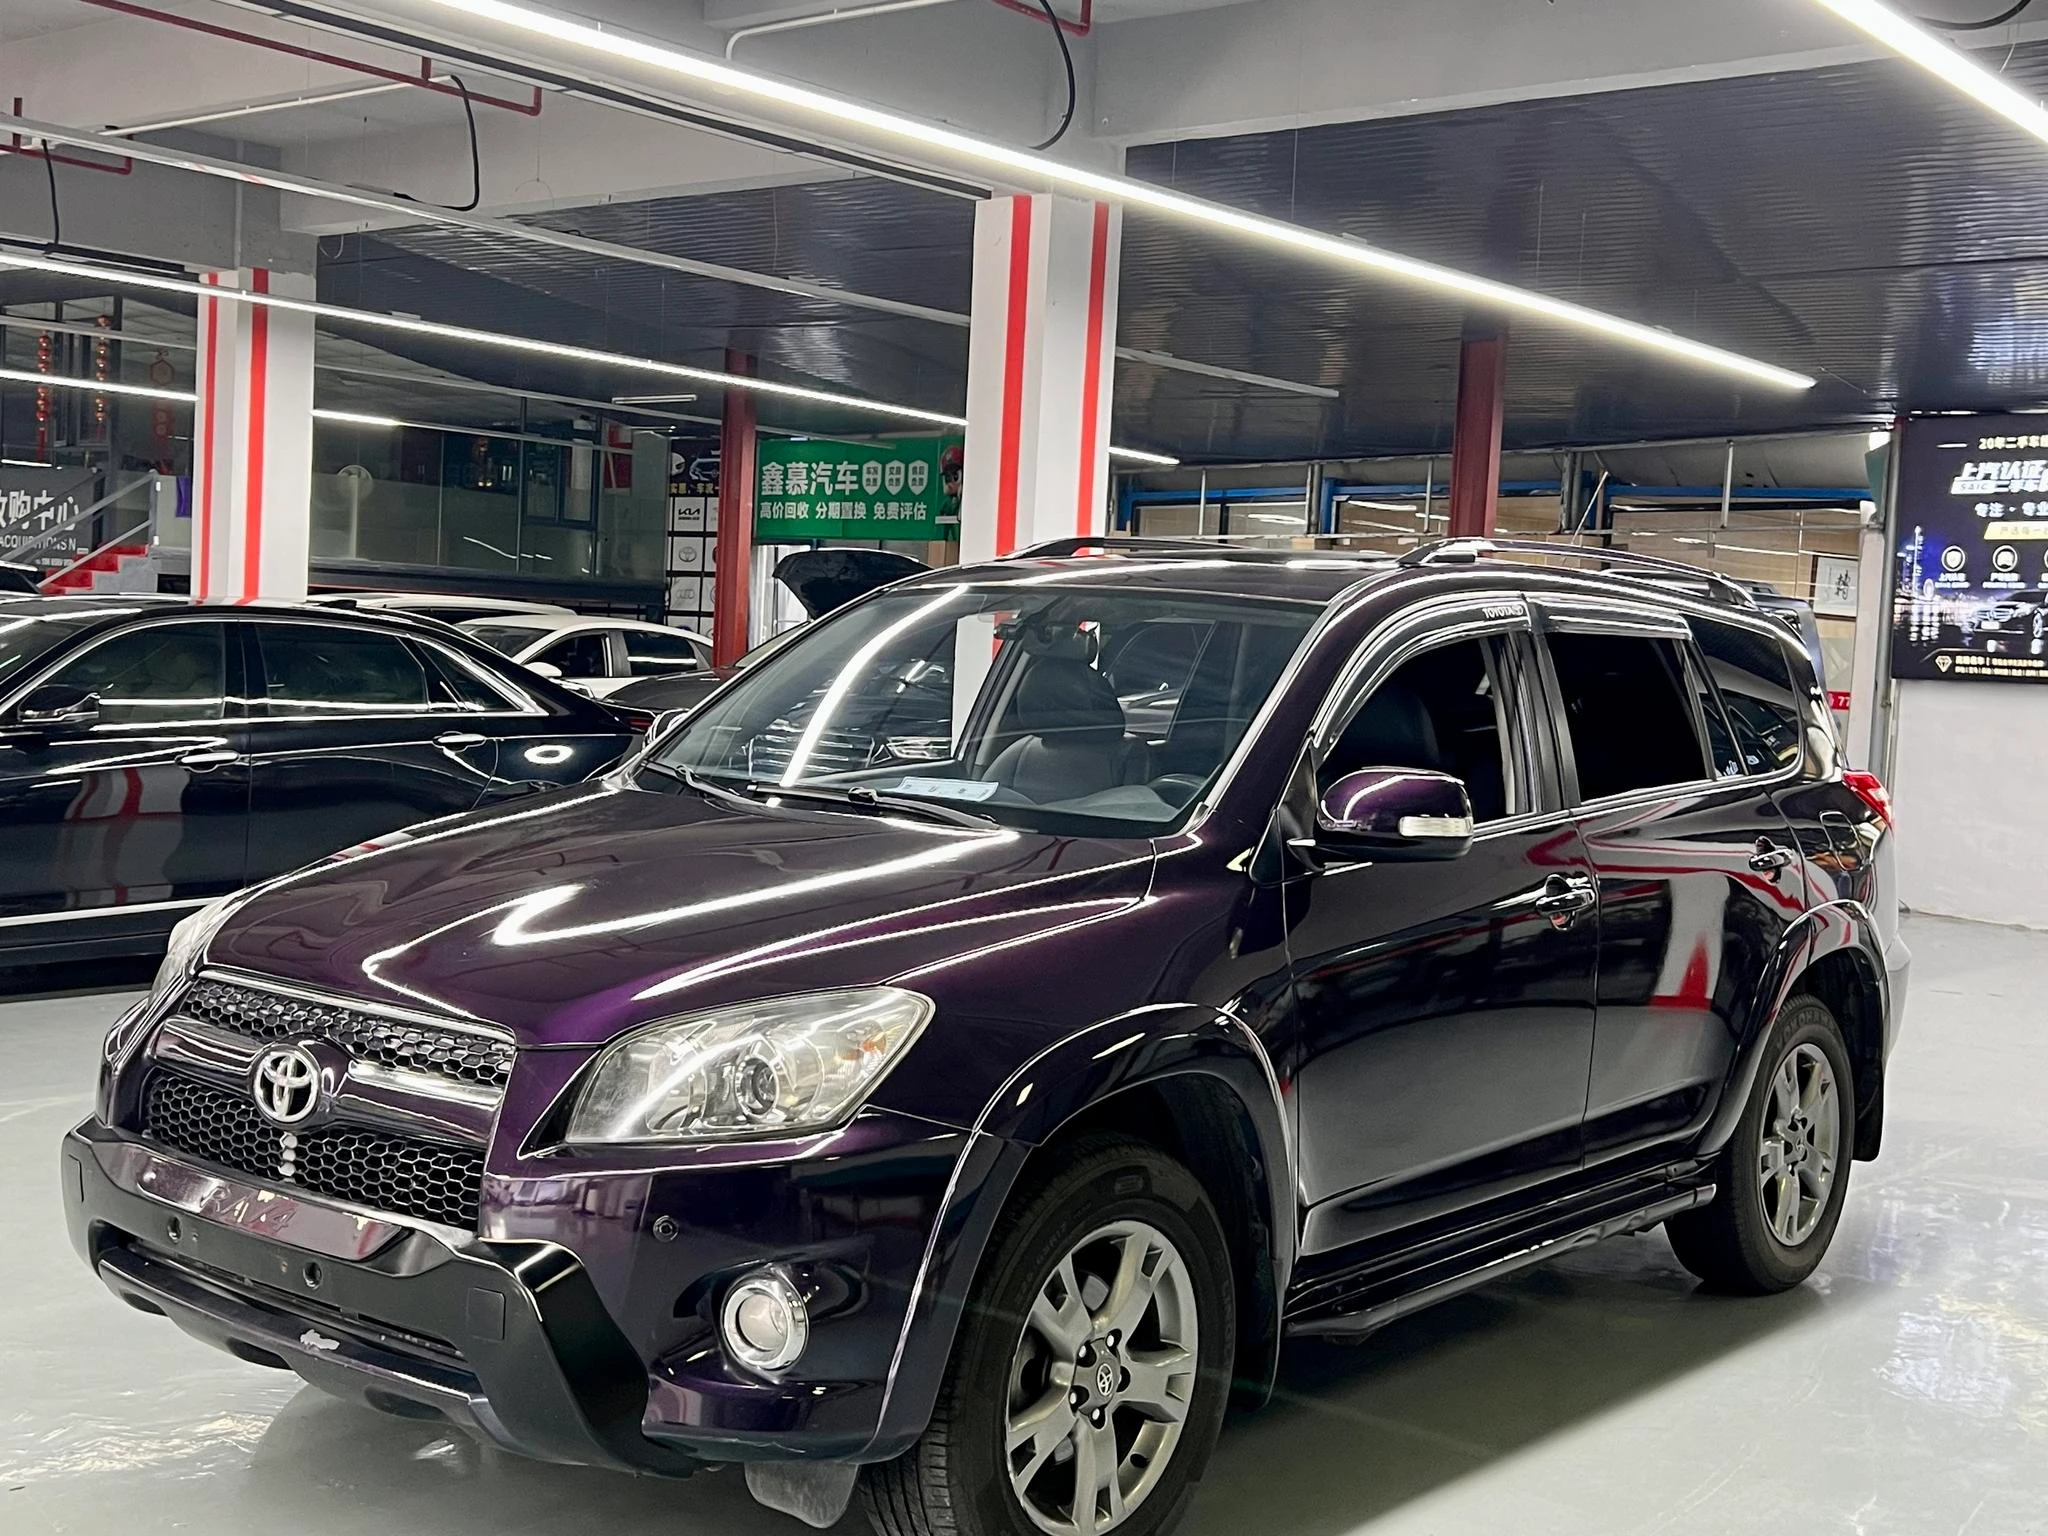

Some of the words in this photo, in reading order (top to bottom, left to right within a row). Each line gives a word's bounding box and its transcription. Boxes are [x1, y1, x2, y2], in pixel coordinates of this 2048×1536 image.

[761, 461, 859, 496] 鑫慕汽车
[760, 501, 810, 519] 高价回收
[815, 501, 867, 519] 分期置换
[873, 502, 926, 520] 免费评估
